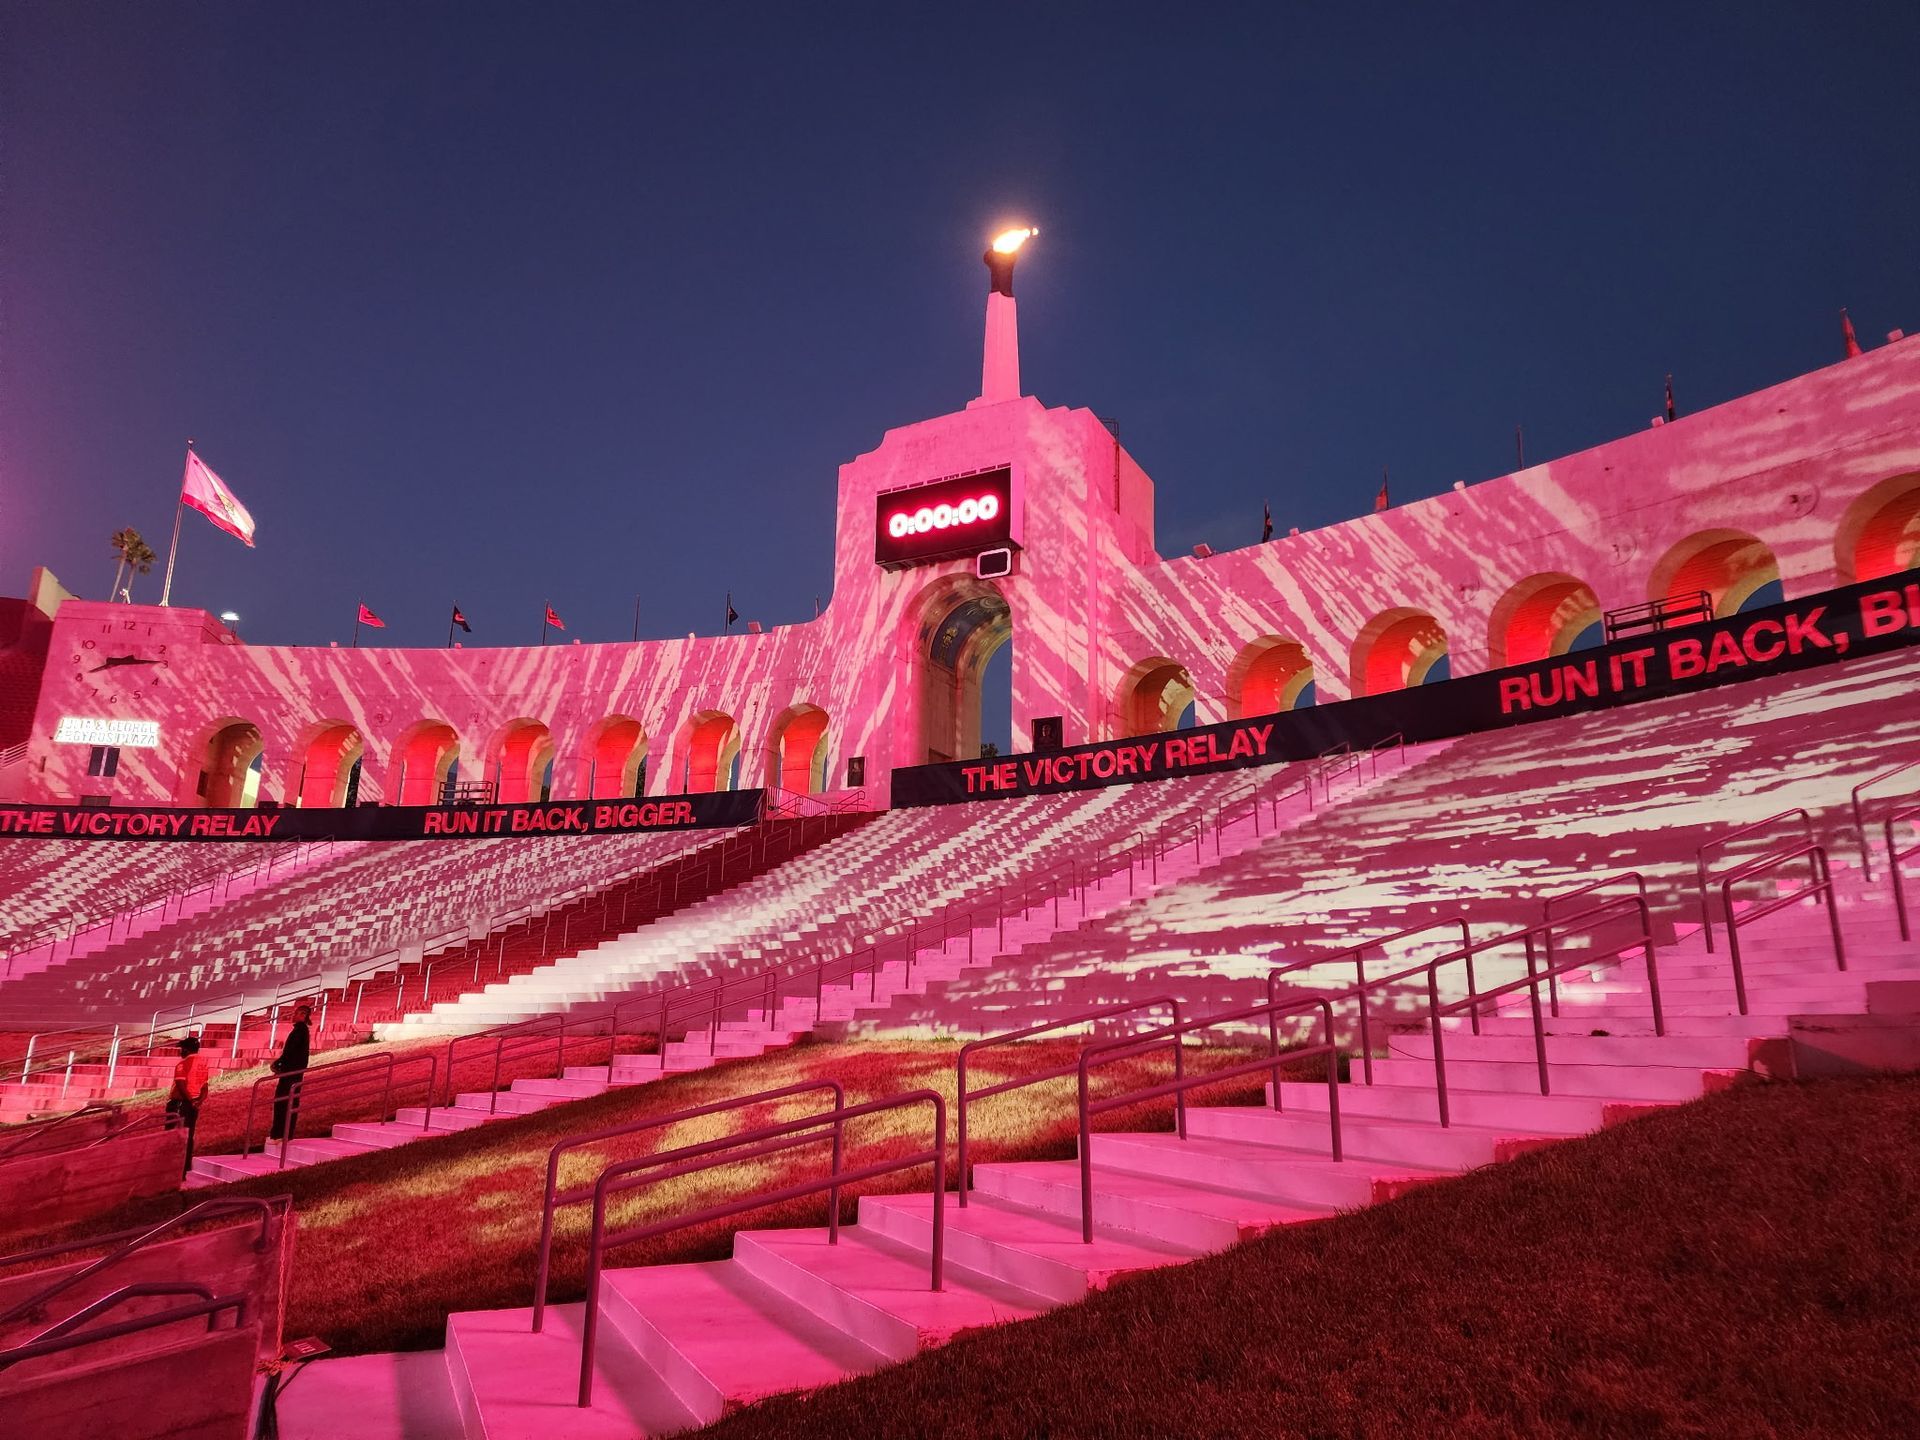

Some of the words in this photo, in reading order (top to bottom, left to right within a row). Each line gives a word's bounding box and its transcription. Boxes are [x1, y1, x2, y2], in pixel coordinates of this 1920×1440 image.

[889, 494, 998, 537] 0:00:00
[102, 625, 112, 633] 11
[124, 621, 136, 631] 12
[82, 640, 96, 650] 10
[159, 645, 167, 654] 2
[1500, 661, 1598, 713] RUN
[1610, 648, 1654, 691] IT
[1669, 607, 1848, 679] BACK,
[1861, 584, 1920, 637] BI
[73, 655, 81, 664] 9
[161, 660, 169, 669] 3
[75, 673, 83, 682] 8
[151, 677, 159, 686] 4
[91, 688, 99, 697] 7
[132, 691, 141, 700] 5
[110, 695, 117, 704] 6
[962, 763, 1017, 793] THE
[1024, 743, 1158, 786] VICTORY
[1166, 725, 1274, 768] RELAY
[424, 812, 479, 834] RUN
[484, 811, 507, 832] IT
[512, 808, 588, 832] BACK,
[595, 802, 697, 828] BIGGER.
[0, 811, 56, 833] THE
[63, 813, 188, 835] VICTORY
[191, 815, 280, 836] RELAY
